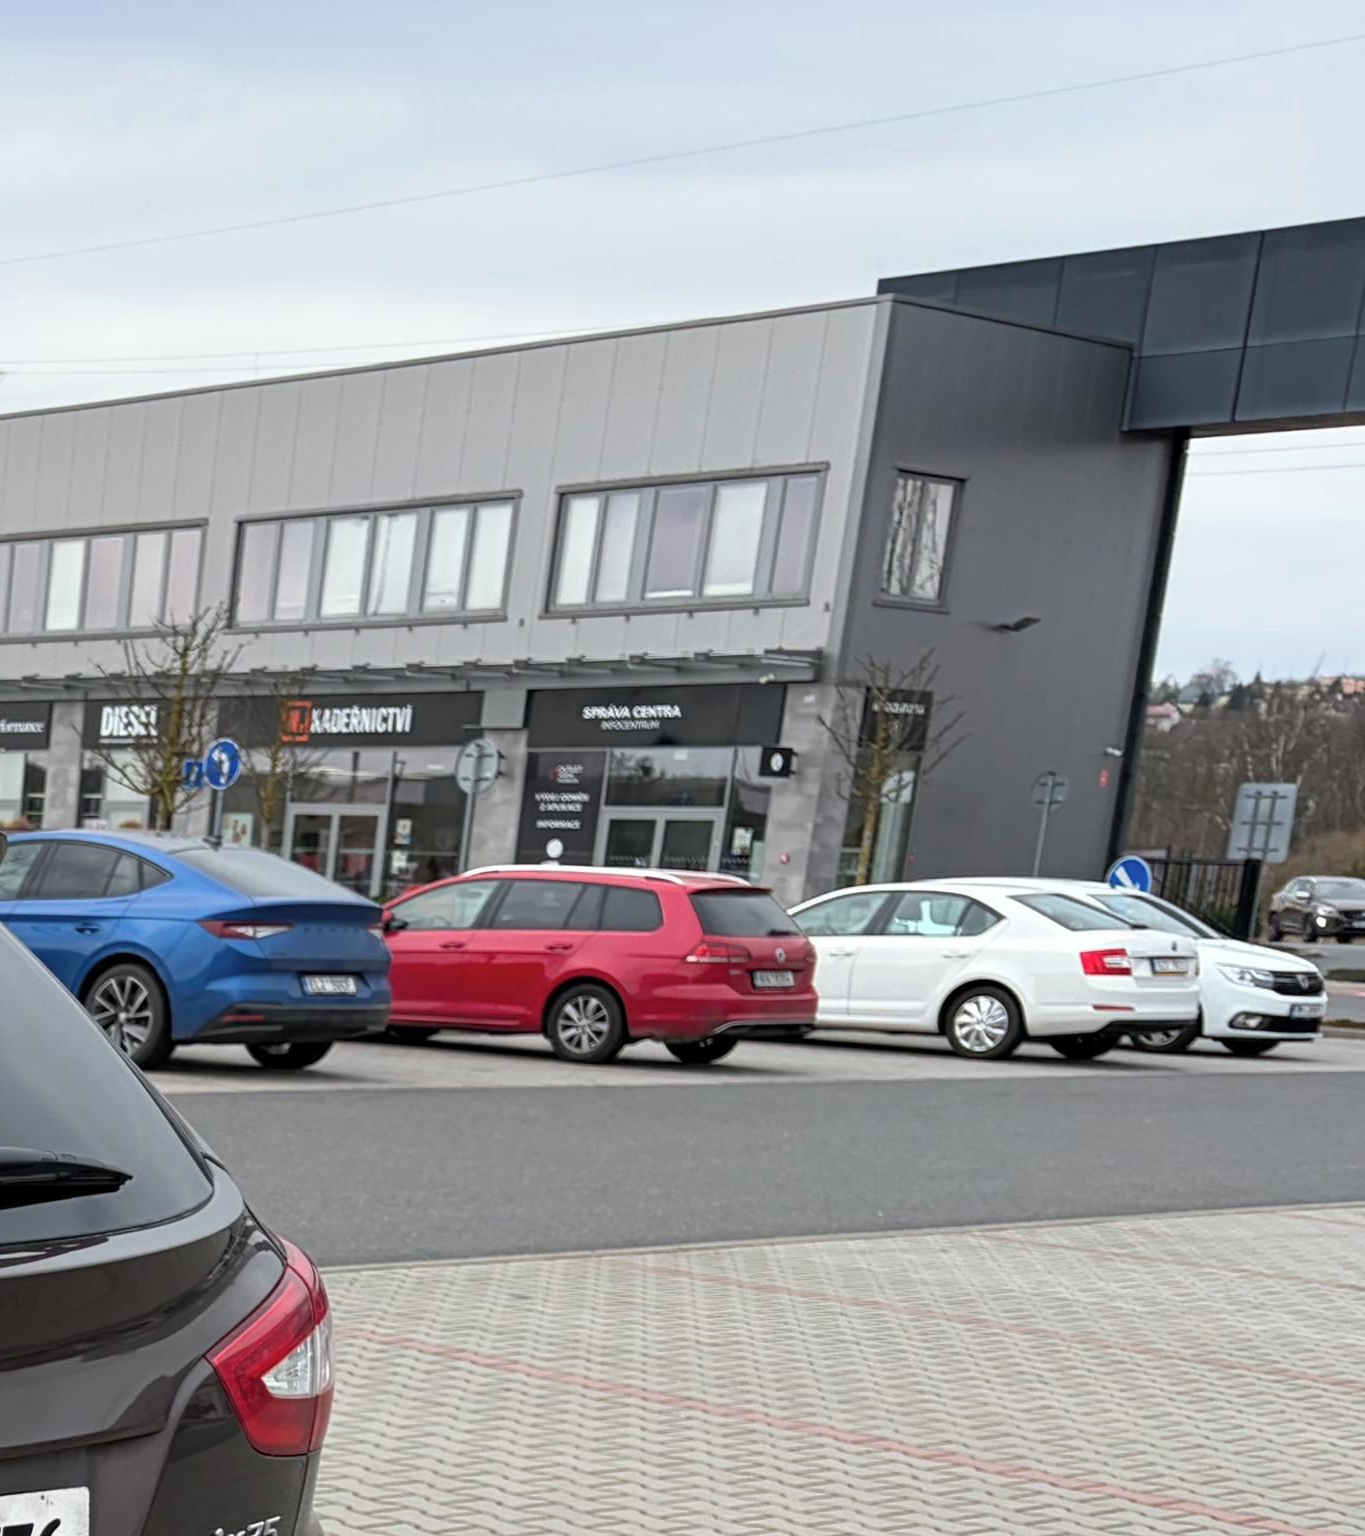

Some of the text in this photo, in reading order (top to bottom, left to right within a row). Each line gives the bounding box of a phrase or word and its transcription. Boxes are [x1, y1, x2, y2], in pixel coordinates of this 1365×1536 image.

[100, 704, 158, 736] DIESEL
[311, 703, 413, 734] KADEŘNICTVÍ
[582, 703, 682, 719] SPRÁVA CENTRA
